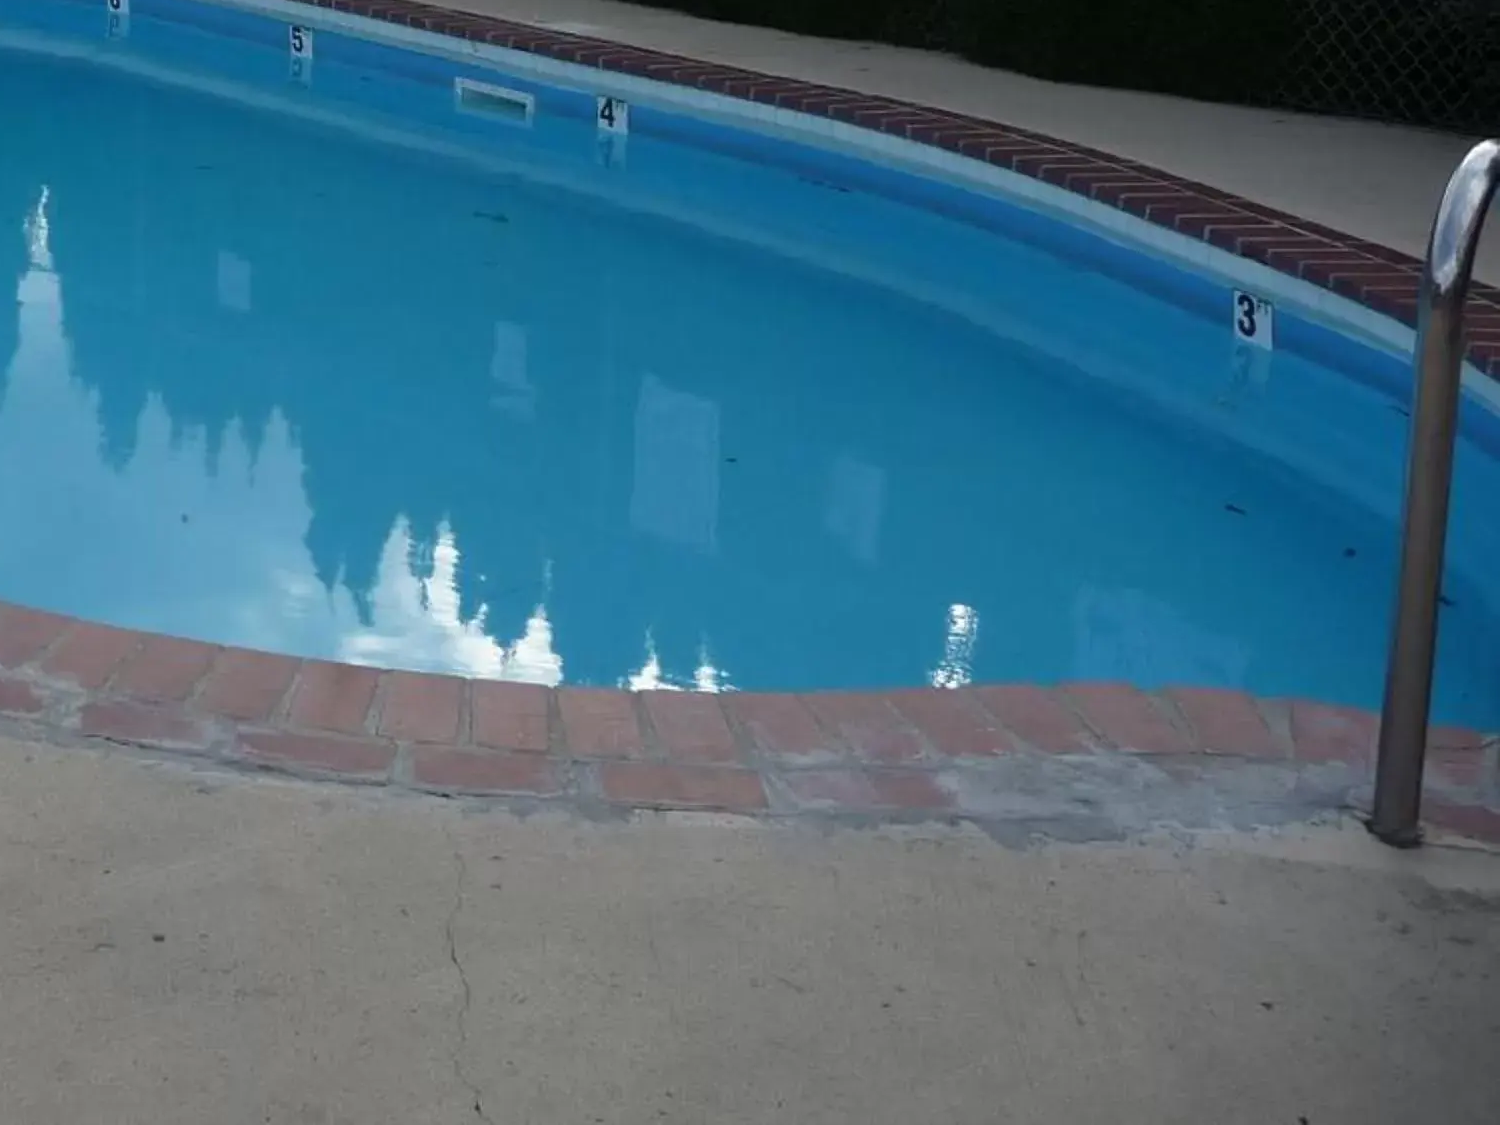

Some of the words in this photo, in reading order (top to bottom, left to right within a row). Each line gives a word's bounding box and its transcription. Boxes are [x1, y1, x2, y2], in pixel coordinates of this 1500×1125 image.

[291, 26, 304, 53] 5
[600, 96, 616, 128] 4
[1237, 294, 1257, 337] 3
